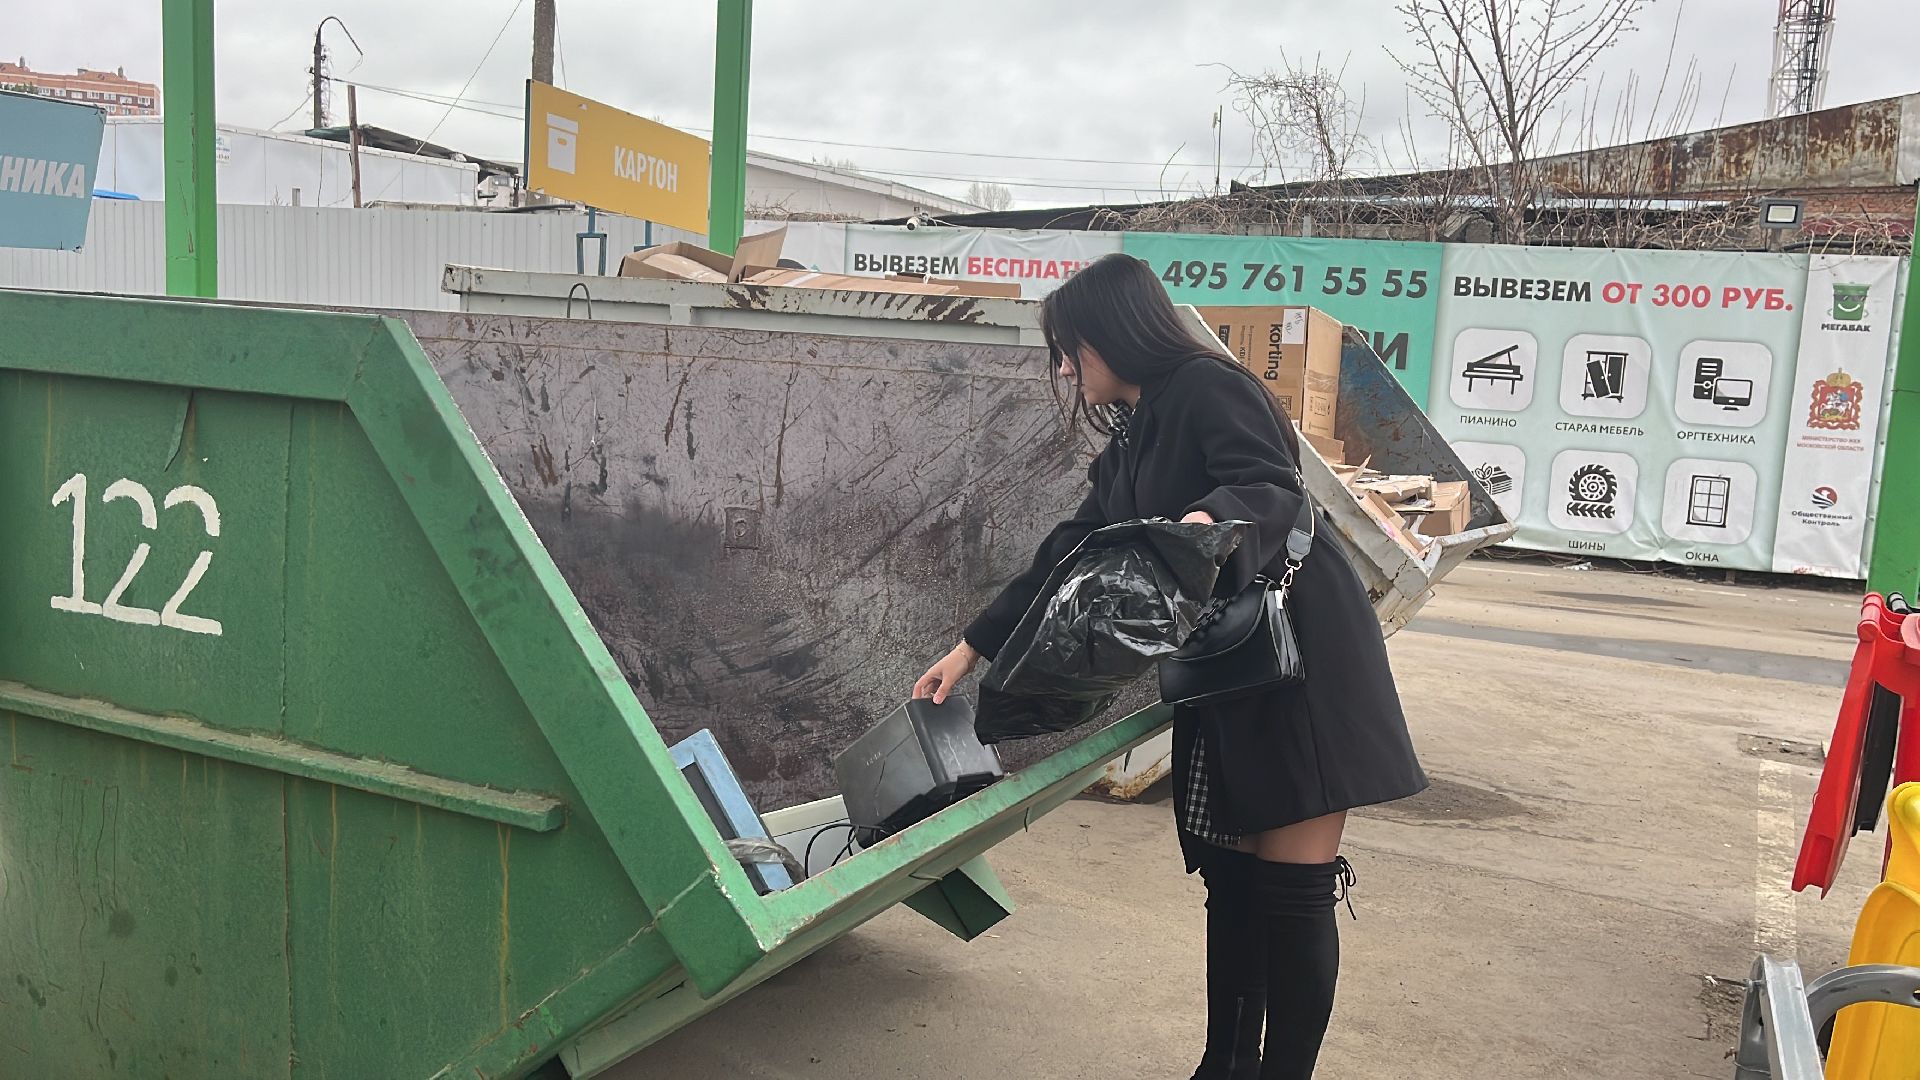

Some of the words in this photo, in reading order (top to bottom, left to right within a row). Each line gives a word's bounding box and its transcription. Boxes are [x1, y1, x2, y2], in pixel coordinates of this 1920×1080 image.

[613, 145, 679, 193] КАРТОН
[0, 155, 85, 199] НИКА
[854, 253, 959, 275] ВЫВЕЗЕМ
[1162, 260, 1228, 290] 495
[1242, 263, 1305, 292] 761
[1322, 266, 1367, 296] 55
[1382, 269, 1428, 298] 55
[1453, 276, 1592, 302] ВЫВЕЗЕМ
[1602, 281, 1643, 304] ОТ
[1652, 284, 1712, 308] 300
[1721, 287, 1793, 311] РУБ.
[1820, 323, 1872, 332] МЕГАБАК
[1460, 415, 1518, 428] ПИАНИНО
[1555, 422, 1598, 433] СТАРАЯ
[1599, 425, 1645, 437] МЕБЕЛЬ
[1677, 431, 1756, 445] ОРГТЕХНИКА
[1791, 510, 1853, 520] Общественный
[1802, 519, 1841, 527] Контроль
[1568, 540, 1607, 551] ШИНЫ
[50, 473, 223, 636] 122
[1685, 551, 1720, 563] ОКНА
